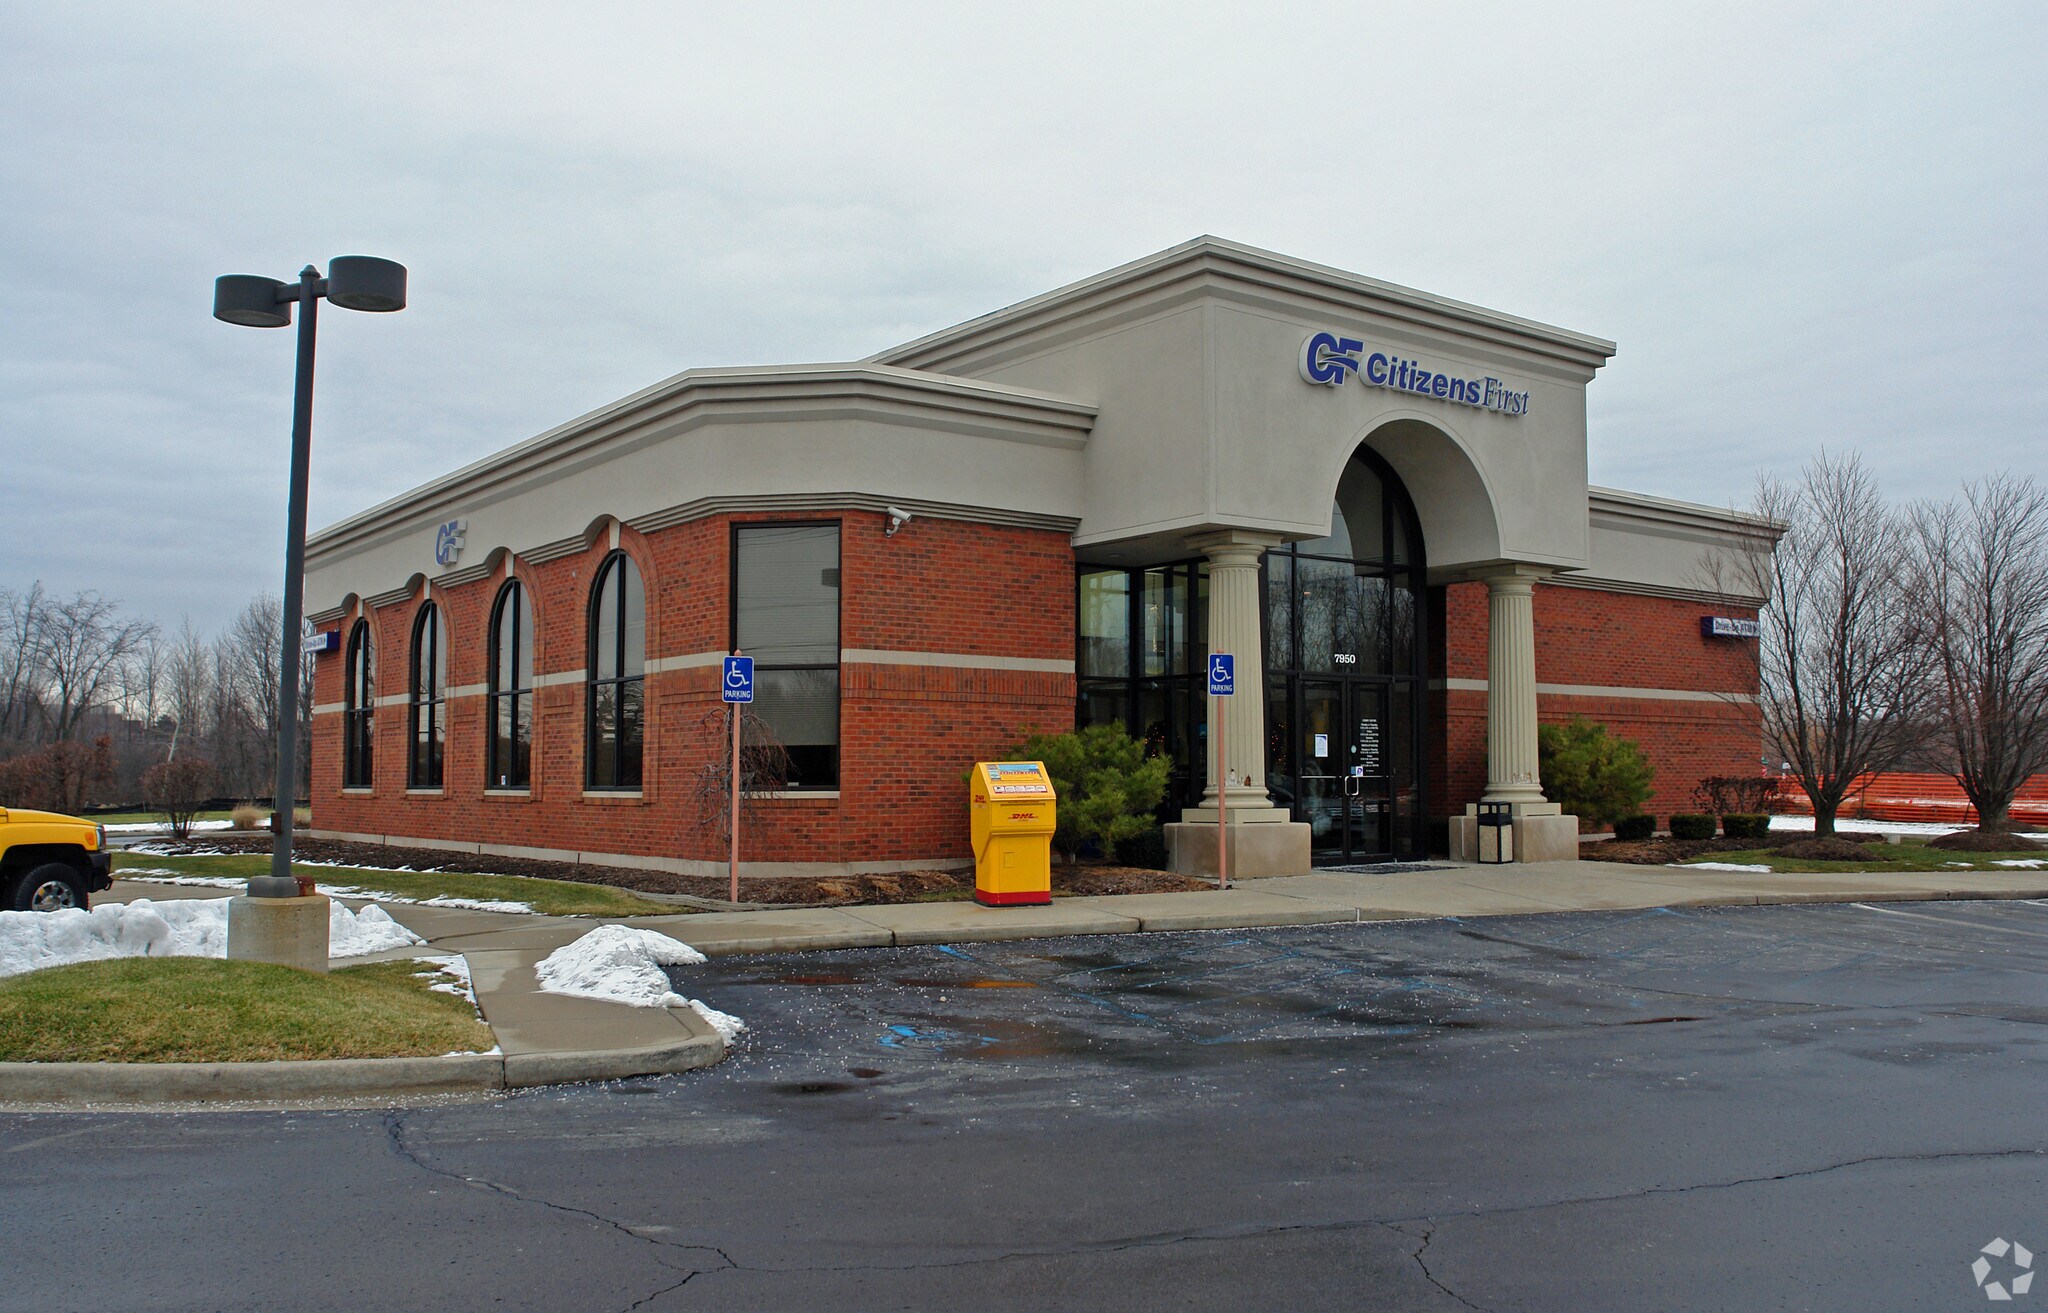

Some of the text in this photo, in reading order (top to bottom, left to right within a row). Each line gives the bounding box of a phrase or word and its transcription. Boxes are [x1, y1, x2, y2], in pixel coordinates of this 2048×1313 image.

[1334, 653, 1356, 664] 7950
[1211, 684, 1233, 692] PARKING
[724, 689, 751, 699] PARKING
[1011, 812, 1036, 820] DHL
